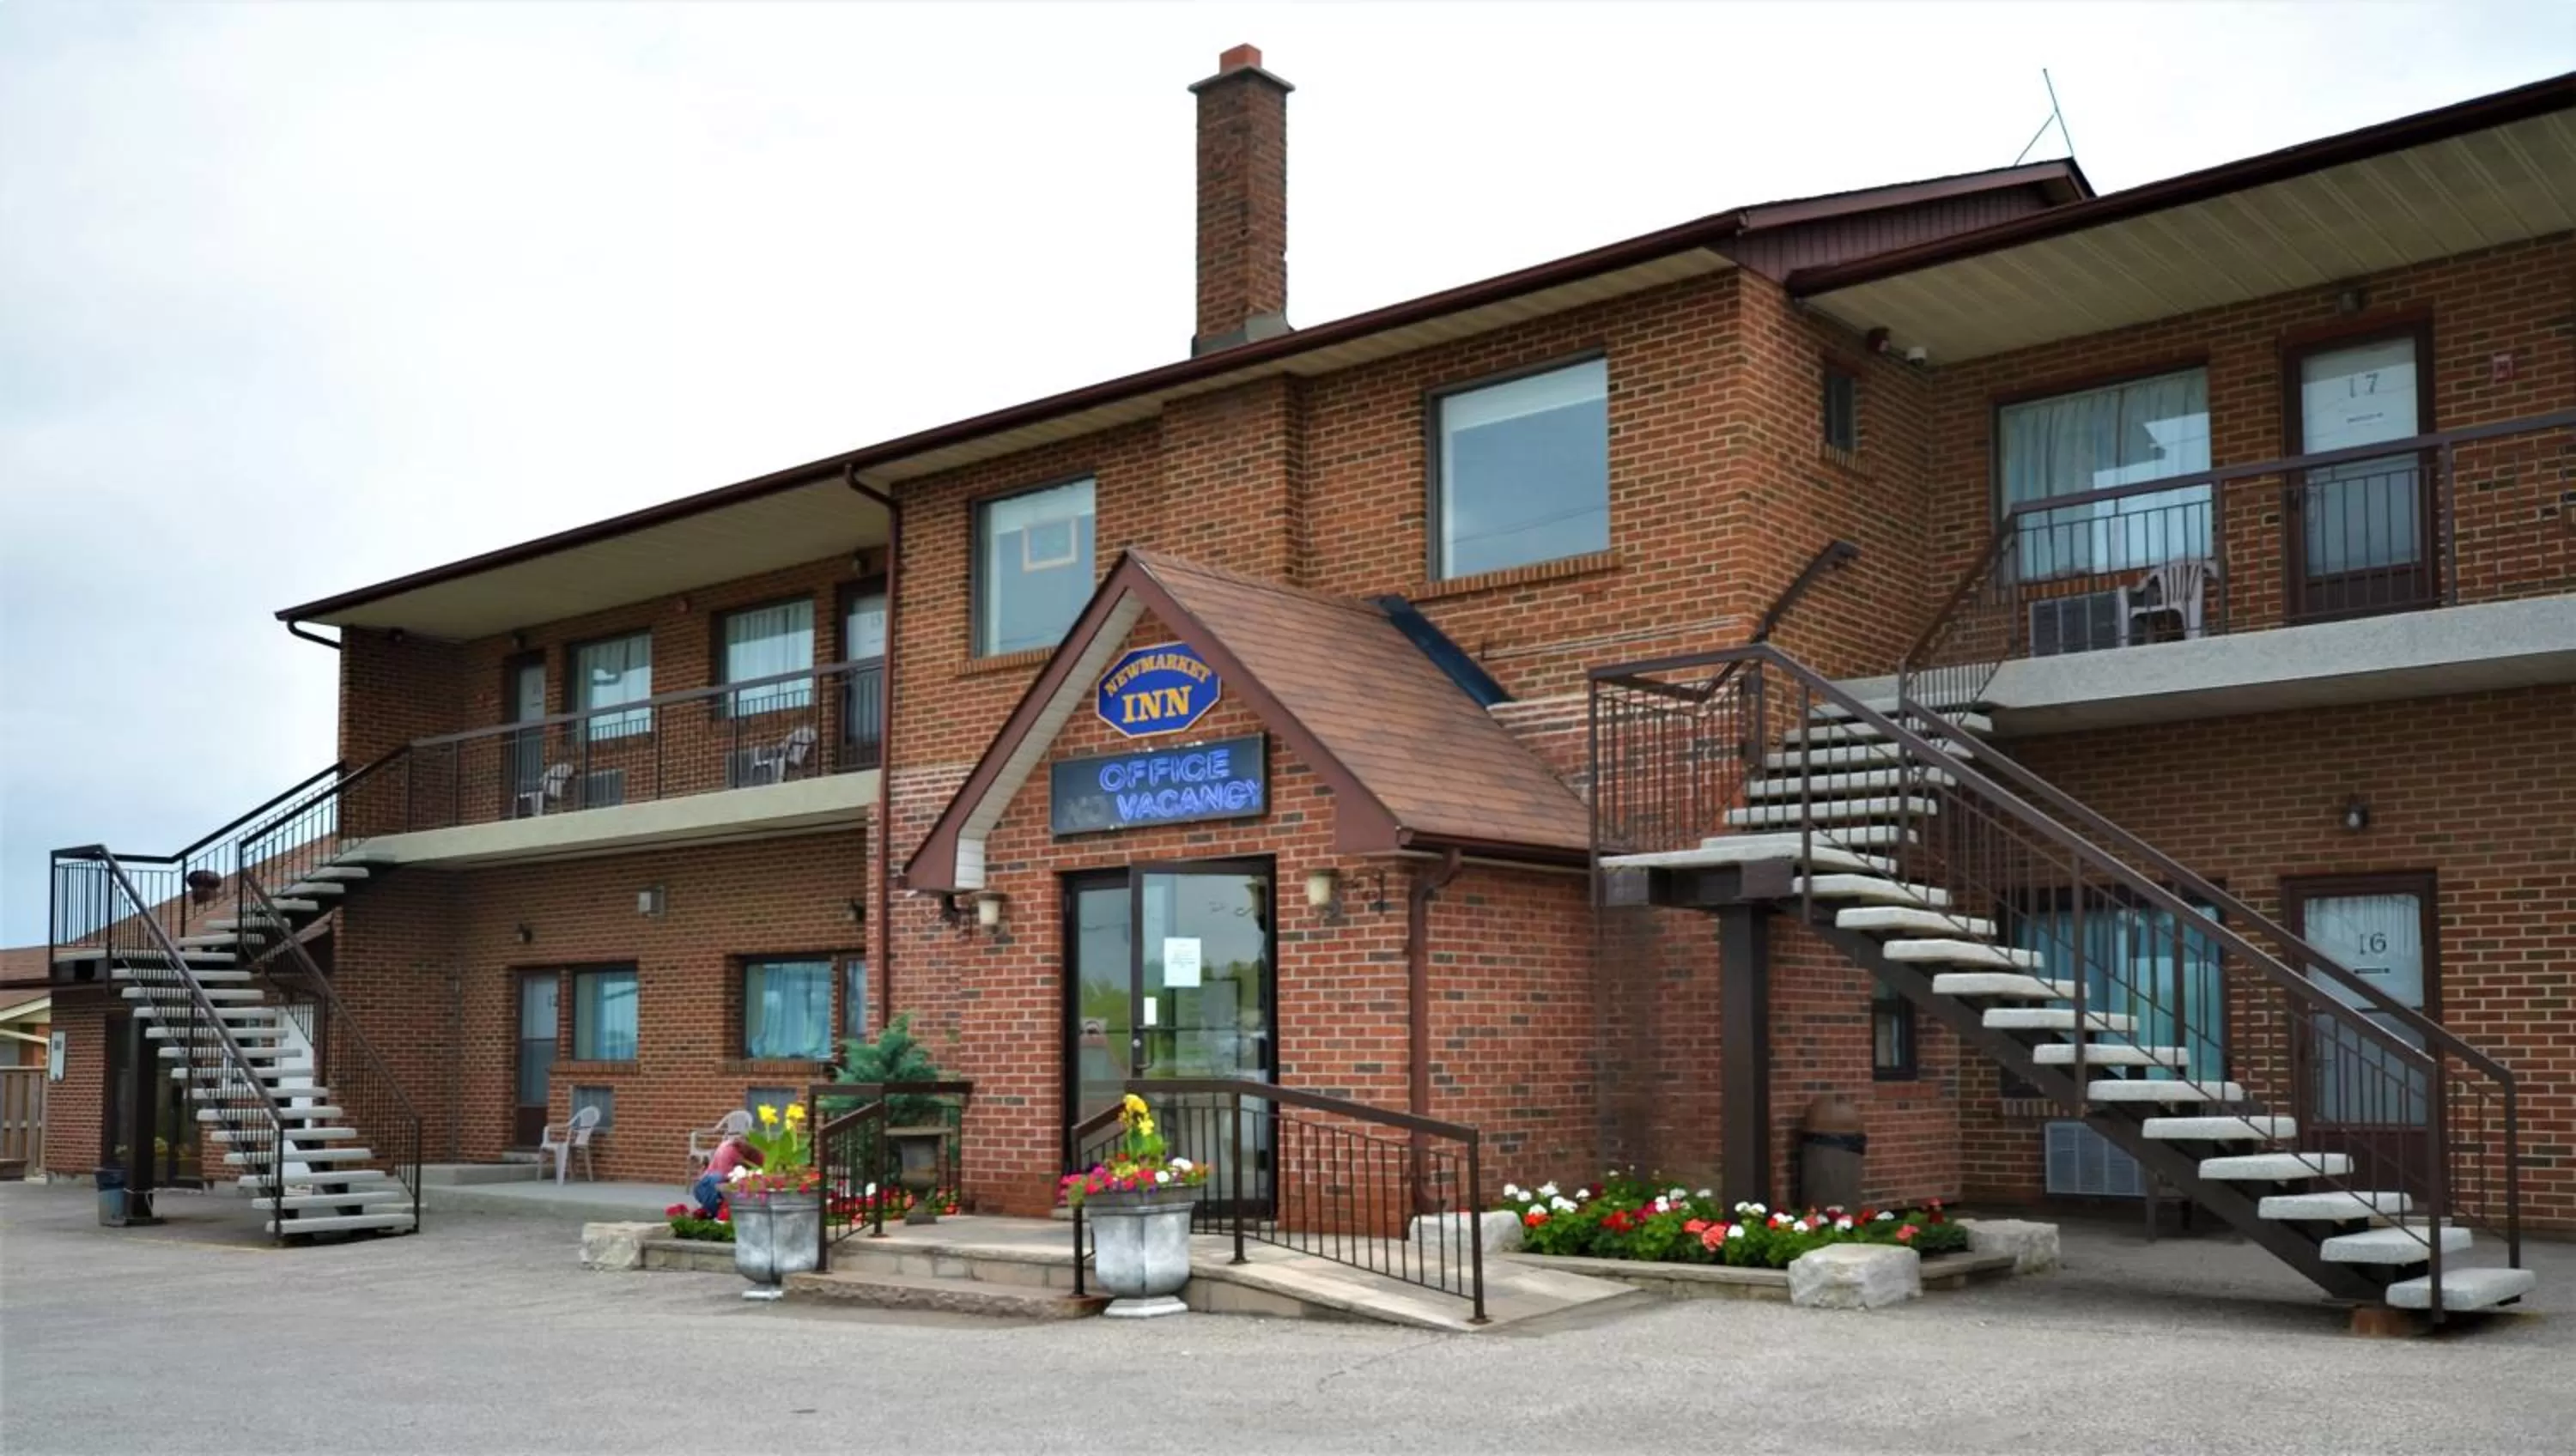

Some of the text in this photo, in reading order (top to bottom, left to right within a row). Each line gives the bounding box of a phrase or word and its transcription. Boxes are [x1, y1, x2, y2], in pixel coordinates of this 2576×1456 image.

[2348, 372, 2379, 398] 17
[1104, 653, 1212, 697] NEWMARKET
[1121, 685, 1192, 724] INN
[1099, 749, 1230, 792] OFFICE
[1116, 779, 1261, 821] VACANCY
[2360, 932, 2387, 956] 16
